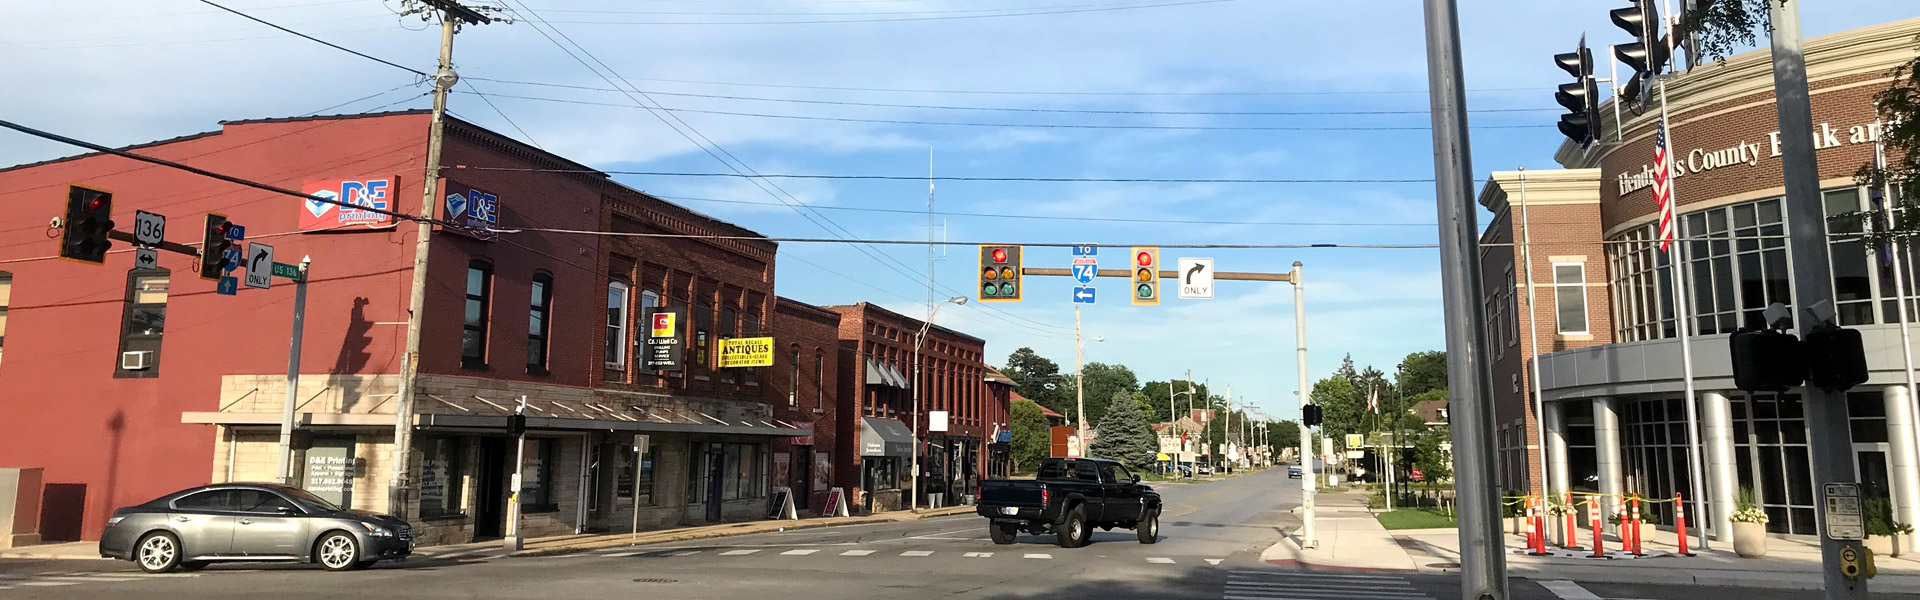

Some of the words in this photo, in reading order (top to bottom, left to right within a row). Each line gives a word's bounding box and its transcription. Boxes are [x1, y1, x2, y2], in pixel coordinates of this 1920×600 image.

[1688, 140, 1760, 173] County
[341, 180, 389, 211] D&E
[467, 188, 497, 223] D&E
[137, 218, 162, 239] 136
[1079, 245, 1091, 253] TO
[274, 265, 284, 274] US
[286, 267, 297, 277] 136
[1074, 265, 1094, 280] 74
[248, 274, 268, 286] ONLY
[1184, 286, 1208, 295] ONLY
[722, 344, 768, 354] ANTIQUES
[310, 456, 326, 464] D&E
